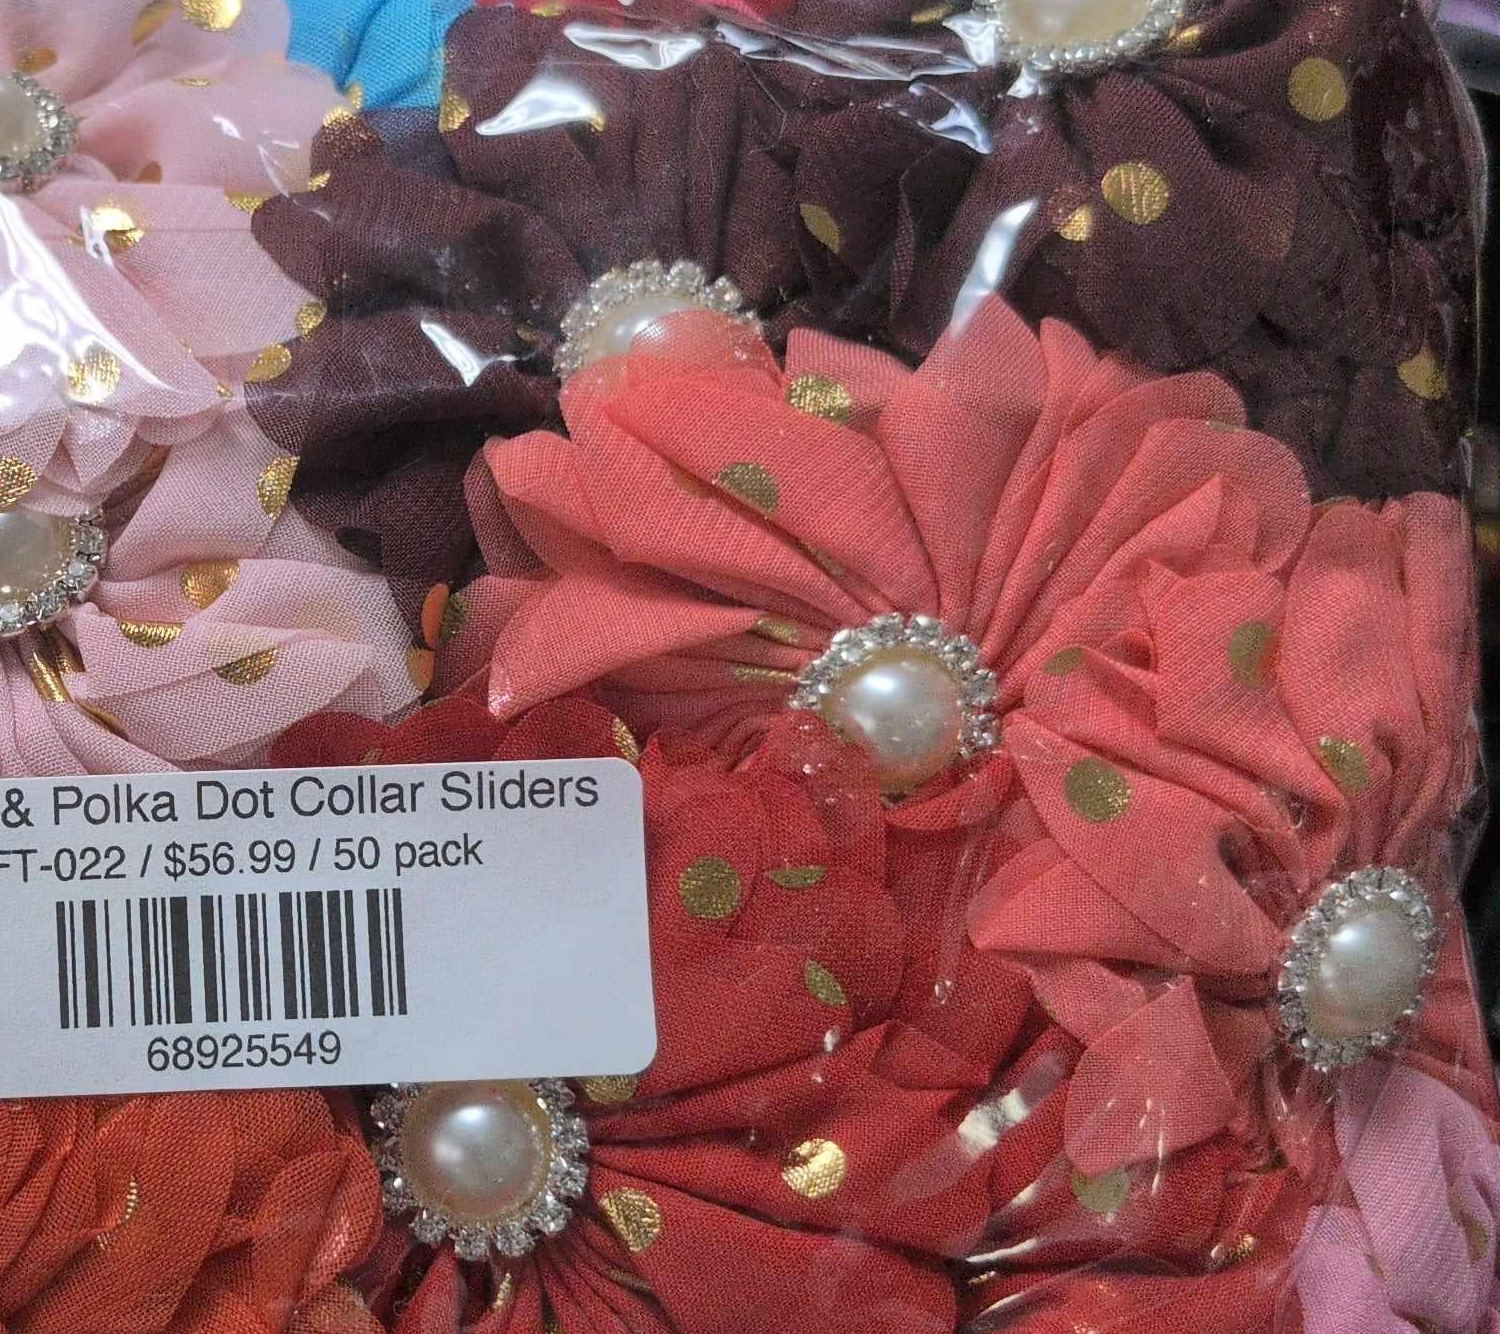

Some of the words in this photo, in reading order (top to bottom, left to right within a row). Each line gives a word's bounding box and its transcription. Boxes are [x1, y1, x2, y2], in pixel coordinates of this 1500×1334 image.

[0, 787, 35, 829] &
[52, 782, 179, 826] Polka
[196, 779, 275, 821] Dot
[290, 774, 425, 817] Collar
[440, 769, 599, 812] Sliders
[139, 843, 153, 878] /
[163, 837, 296, 883] $56.99
[308, 837, 322, 872] /
[333, 836, 381, 871] 50
[394, 832, 484, 877] pack
[147, 1029, 342, 1072] 68925549
